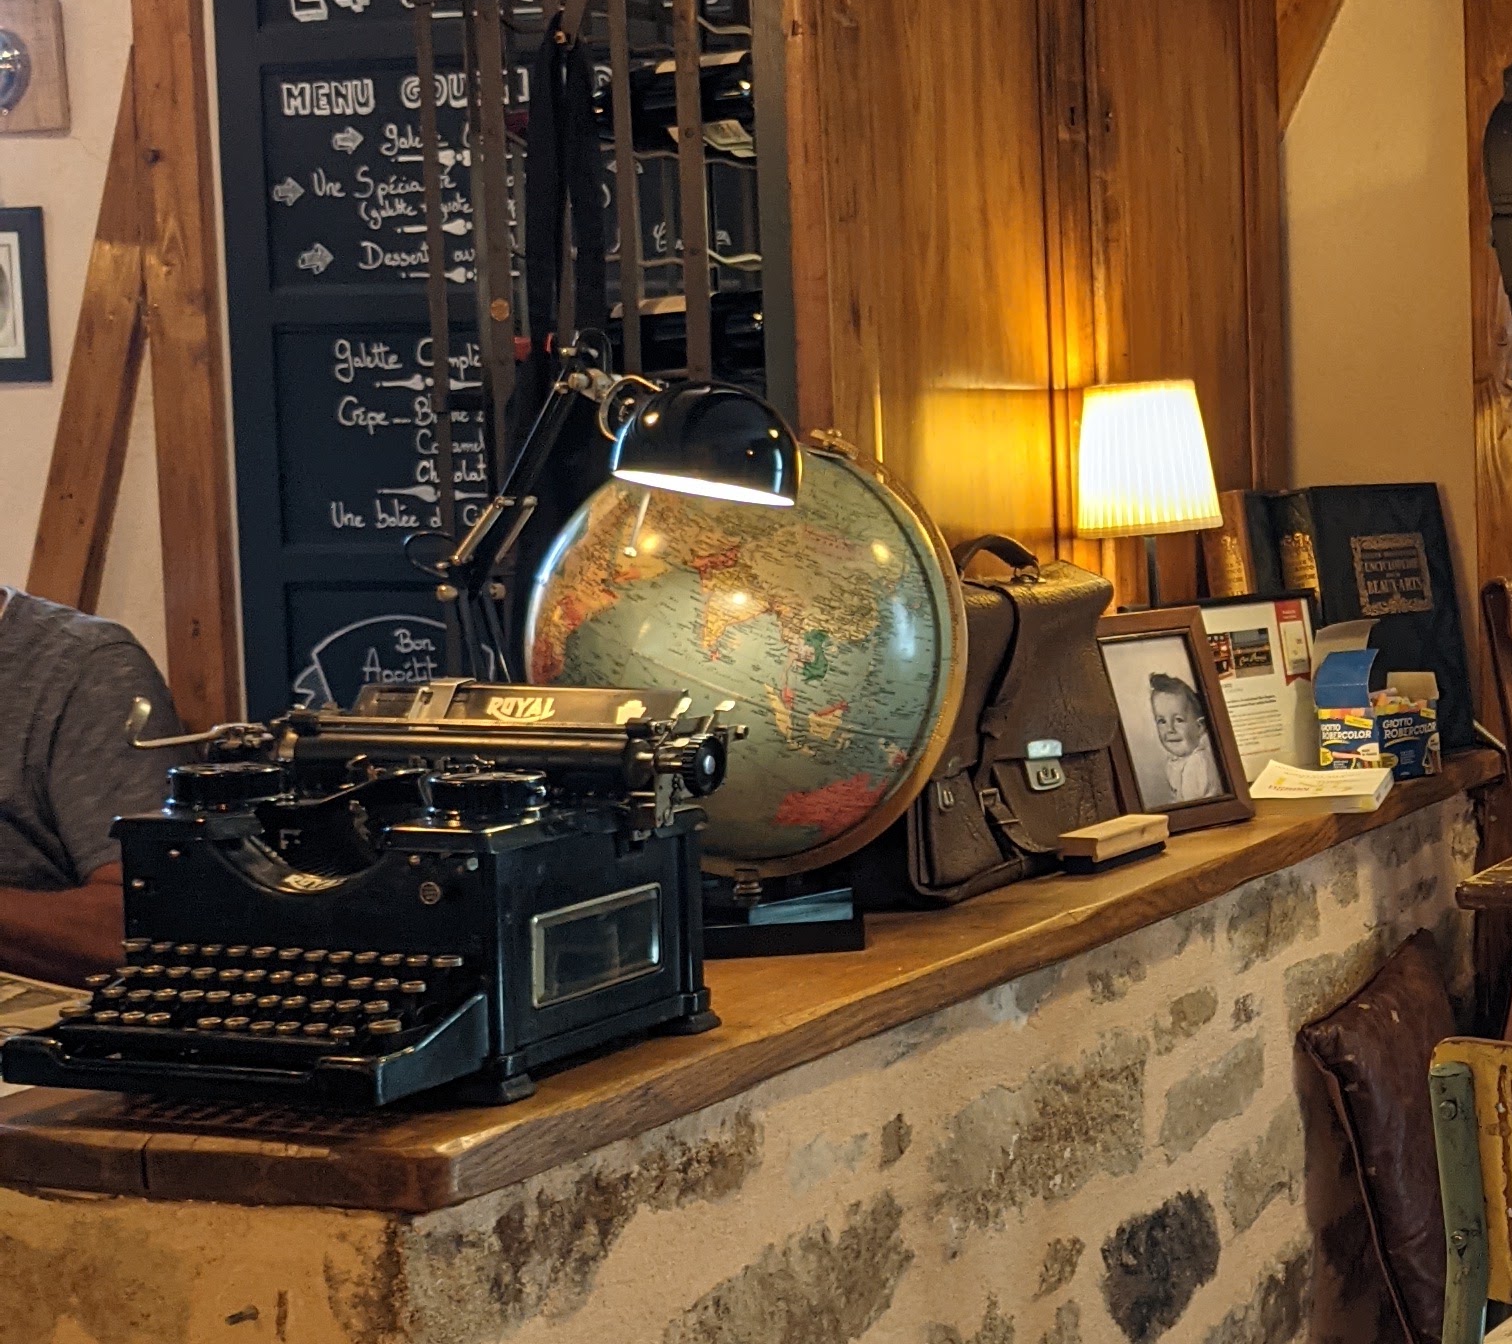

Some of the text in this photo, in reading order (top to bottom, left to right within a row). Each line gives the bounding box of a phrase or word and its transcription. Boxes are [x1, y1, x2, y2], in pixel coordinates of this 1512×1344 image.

[281, 77, 375, 116] MENU
[313, 165, 456, 206] Une Spéciaté
[358, 241, 429, 270] Dessert
[416, 454, 487, 483] Cholat
[331, 501, 365, 529] Une
[376, 499, 420, 529] bolée
[394, 628, 435, 652] Bon
[486, 697, 555, 722] ROYAL
